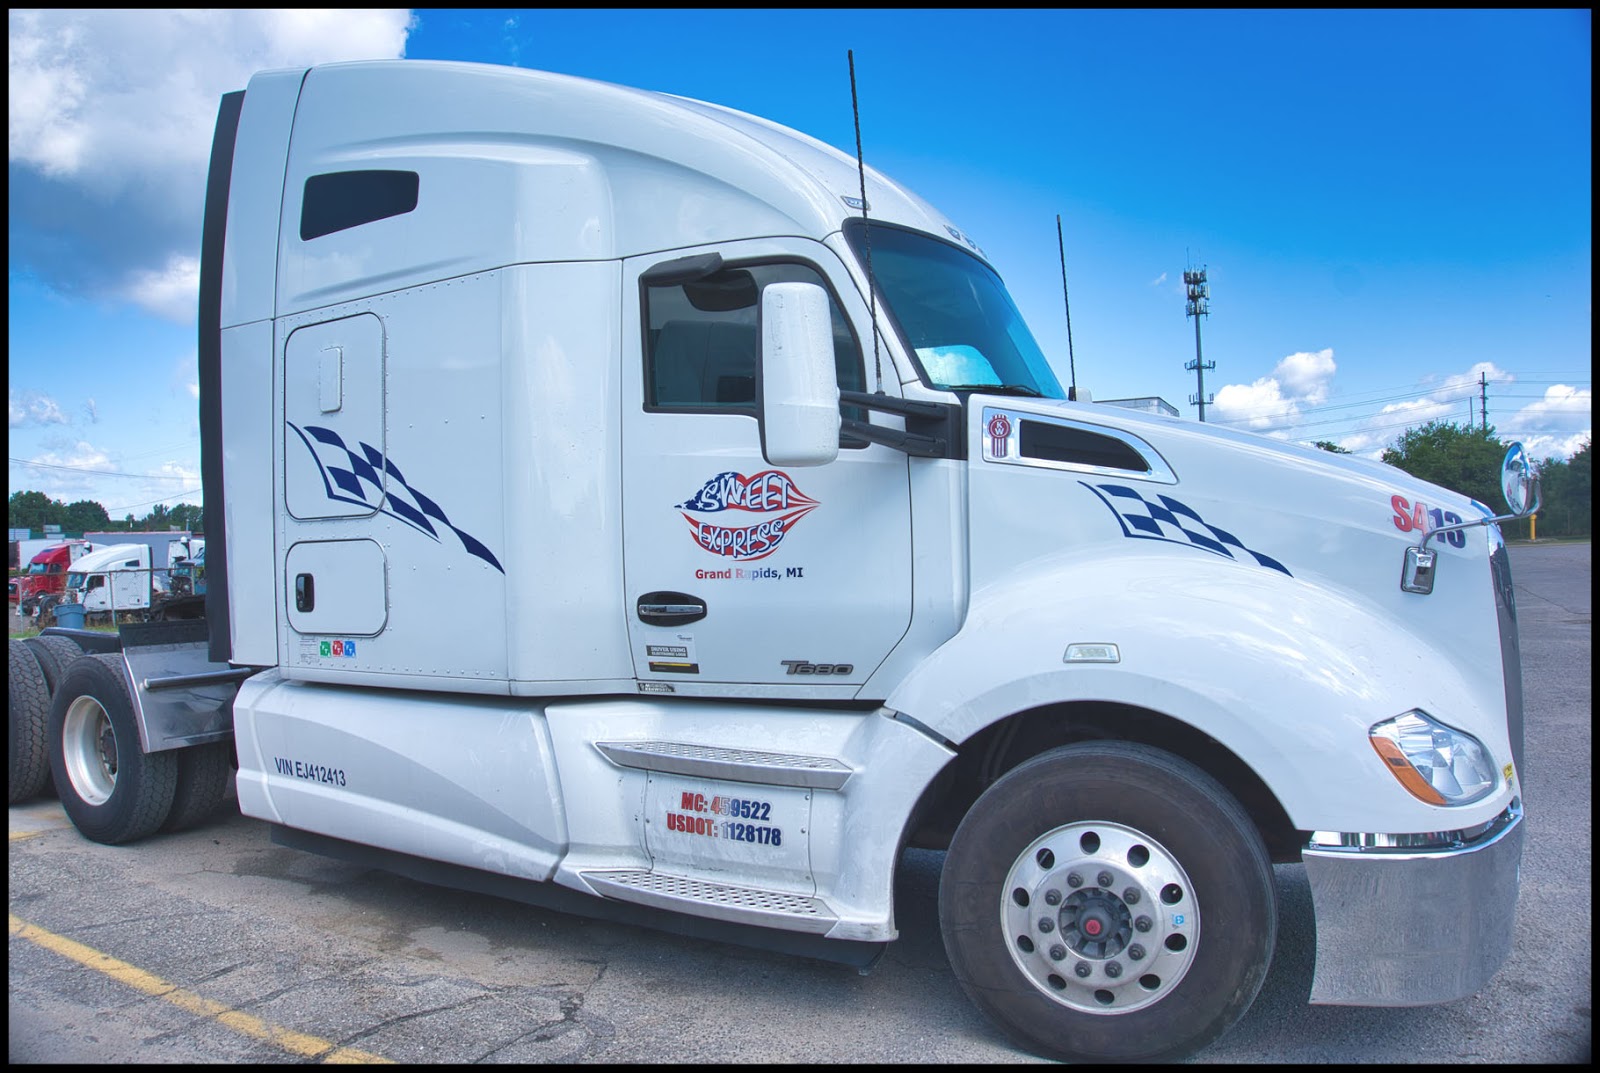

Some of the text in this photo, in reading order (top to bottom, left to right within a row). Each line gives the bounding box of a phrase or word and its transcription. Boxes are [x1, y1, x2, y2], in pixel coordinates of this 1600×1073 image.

[701, 472, 793, 512] SWEET
[1391, 494, 1466, 549] S413
[698, 518, 786, 559] EXPRESS
[695, 567, 804, 581] Grand Rapids, MI
[781, 660, 854, 675] T680
[274, 757, 346, 787] VIN EJ412413
[681, 791, 771, 821] MC: 459522
[667, 813, 782, 846] USDOT: 1128178
